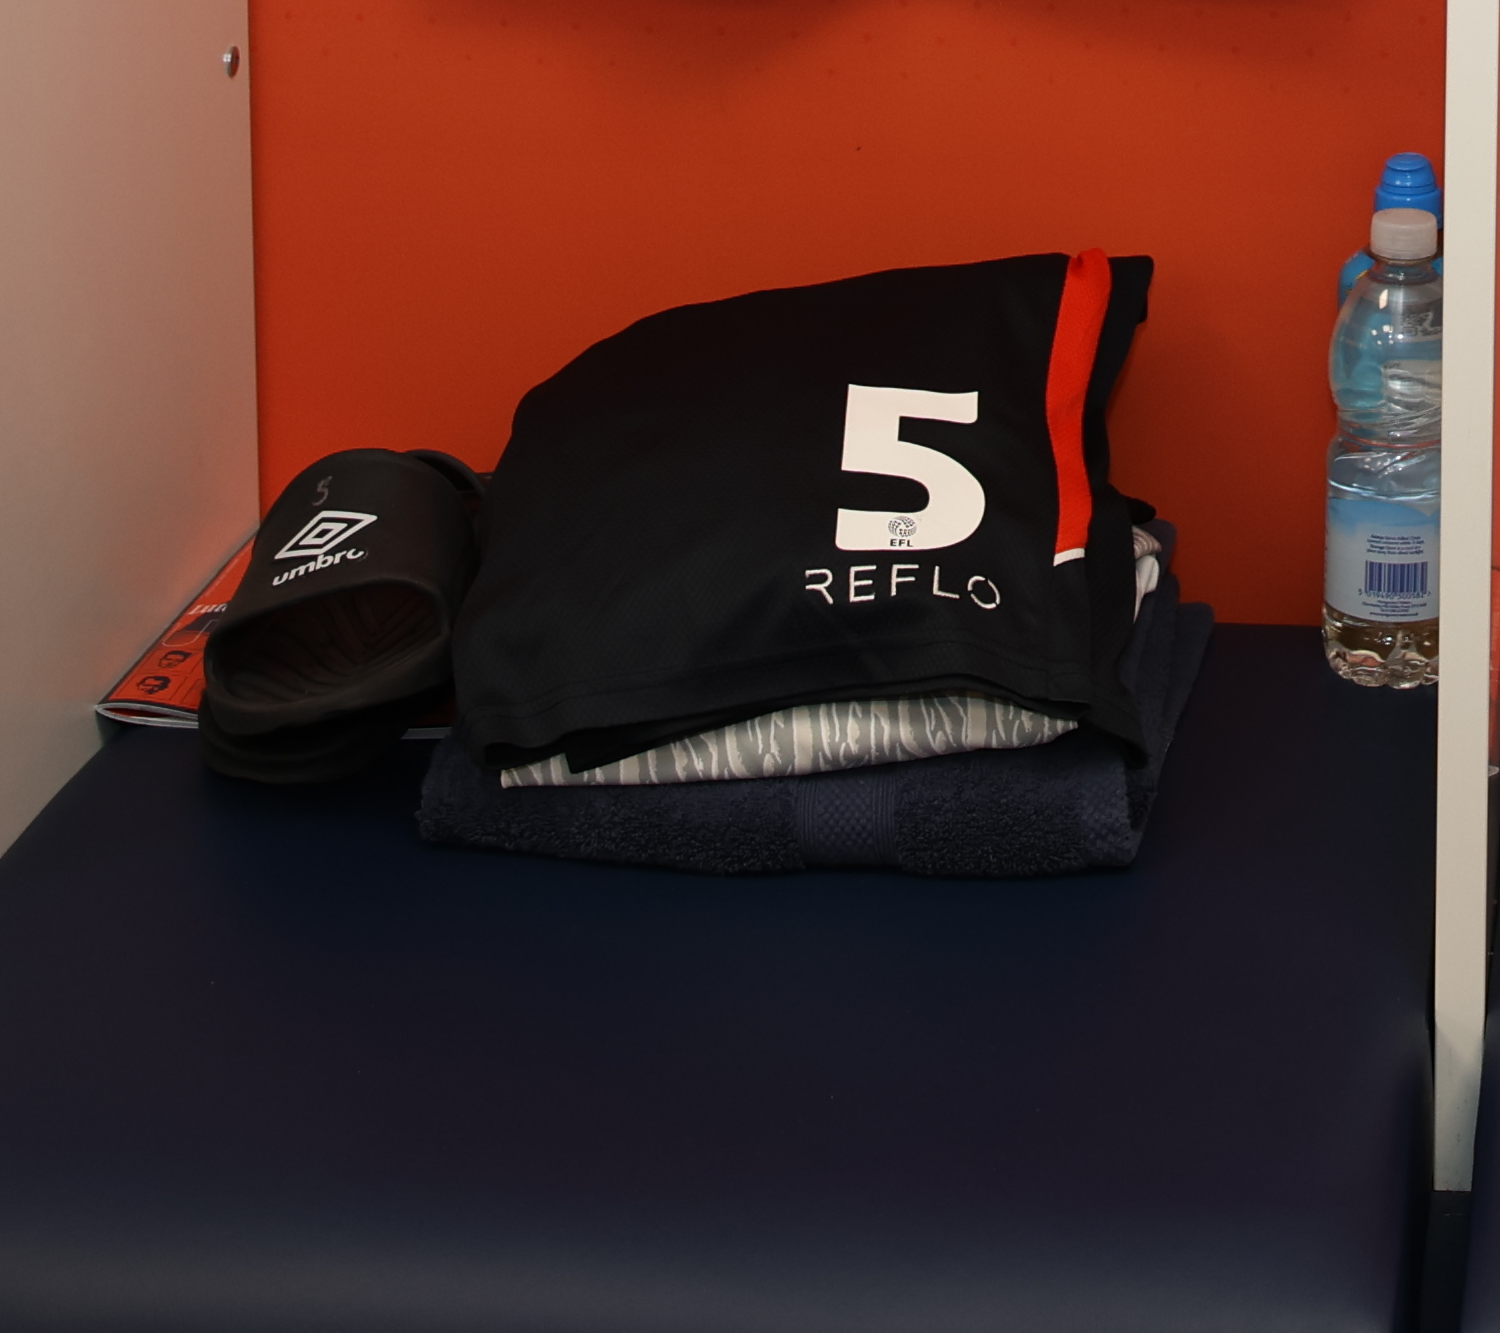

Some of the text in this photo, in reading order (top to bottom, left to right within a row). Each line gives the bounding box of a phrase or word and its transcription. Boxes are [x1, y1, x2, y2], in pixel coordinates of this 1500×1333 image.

[835, 383, 986, 551] 5
[311, 475, 333, 506] 5
[889, 538, 914, 549] EFL
[805, 564, 1001, 610] REFLO
